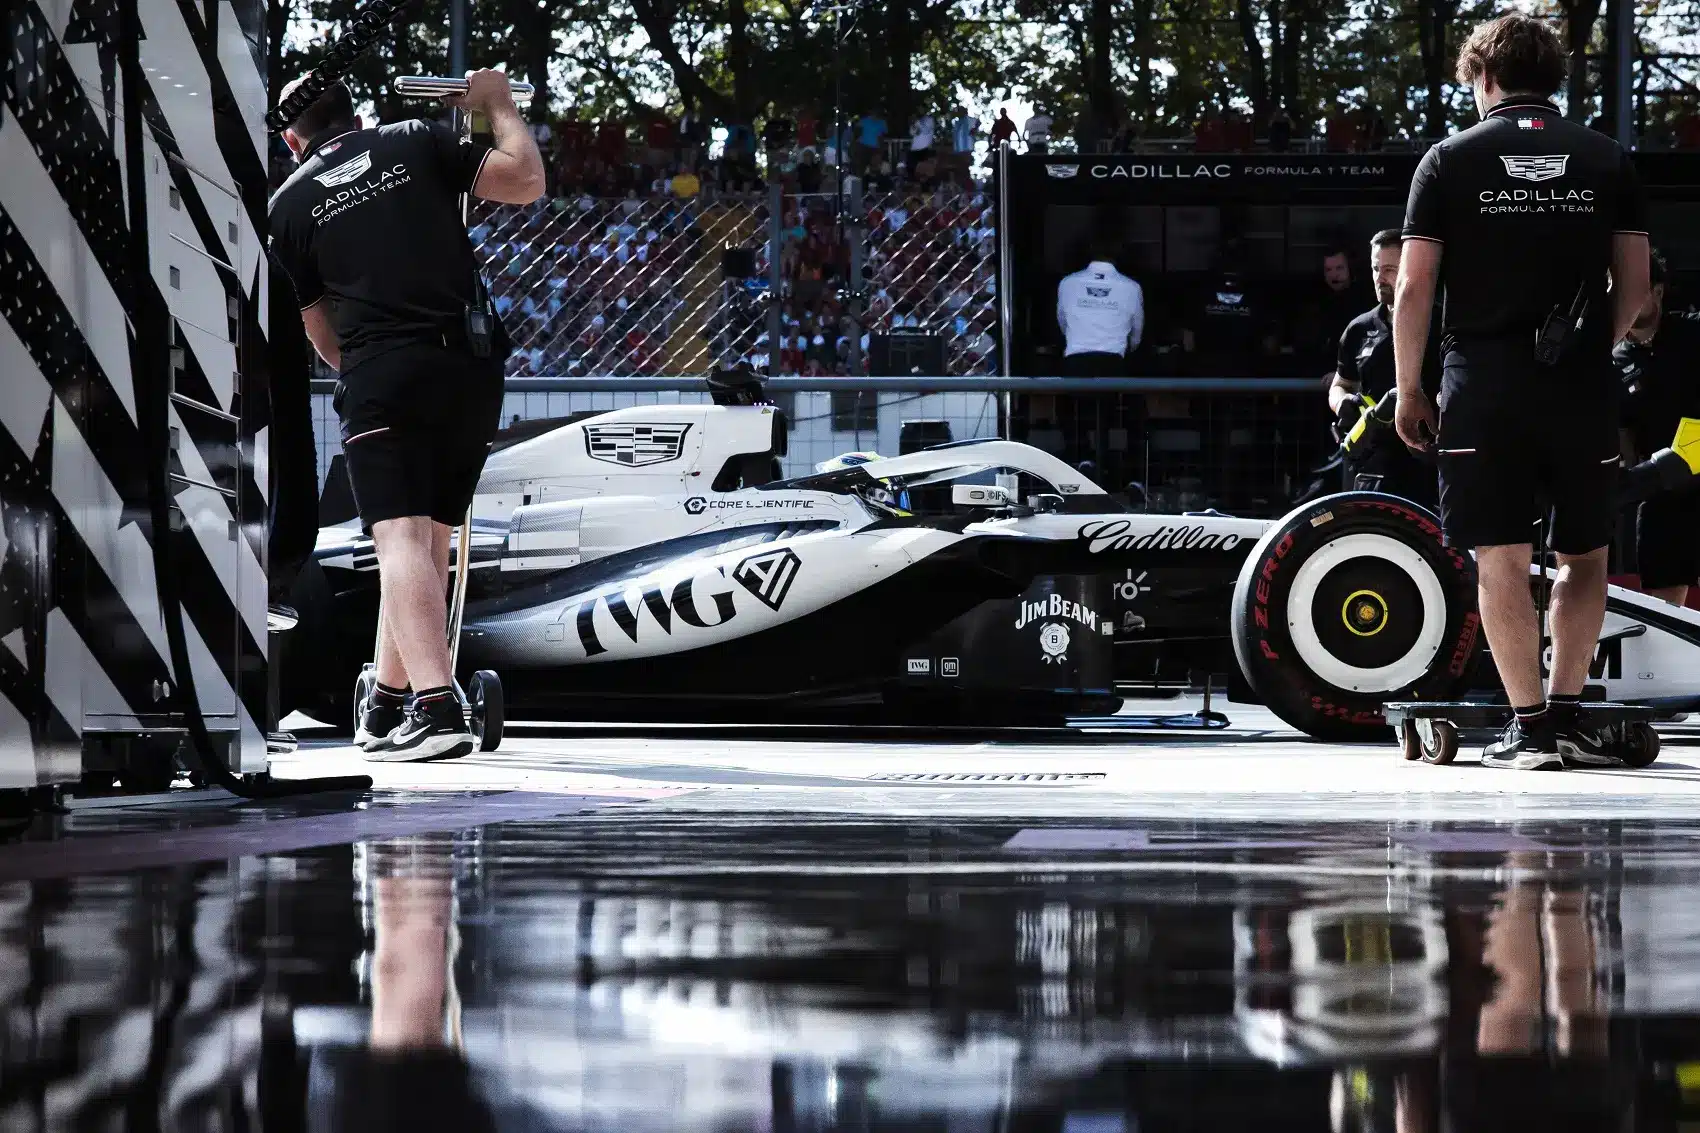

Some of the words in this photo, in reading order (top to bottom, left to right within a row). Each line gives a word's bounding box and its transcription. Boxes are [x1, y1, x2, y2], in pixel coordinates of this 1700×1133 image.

[1090, 164, 1232, 178] CADILLAC
[1243, 166, 1322, 175] FORMULA
[1327, 166, 1334, 175] 1
[1340, 166, 1385, 175] TEAM
[311, 163, 406, 217] CADILLAC
[317, 195, 370, 227] FORMULA
[379, 175, 412, 193] TEAM
[1479, 188, 1594, 202] CADILLAC
[1480, 205, 1546, 214] FORMULA
[1549, 204, 1557, 212] 1
[1560, 204, 1594, 213] TEAM
[709, 501, 744, 509] CORE
[1078, 520, 1240, 553] Cadillac
[1254, 531, 1294, 629] ZERO
[1015, 600, 1048, 630] JIM
[1049, 593, 1097, 632] BEAM
[944, 661, 956, 673] gm
